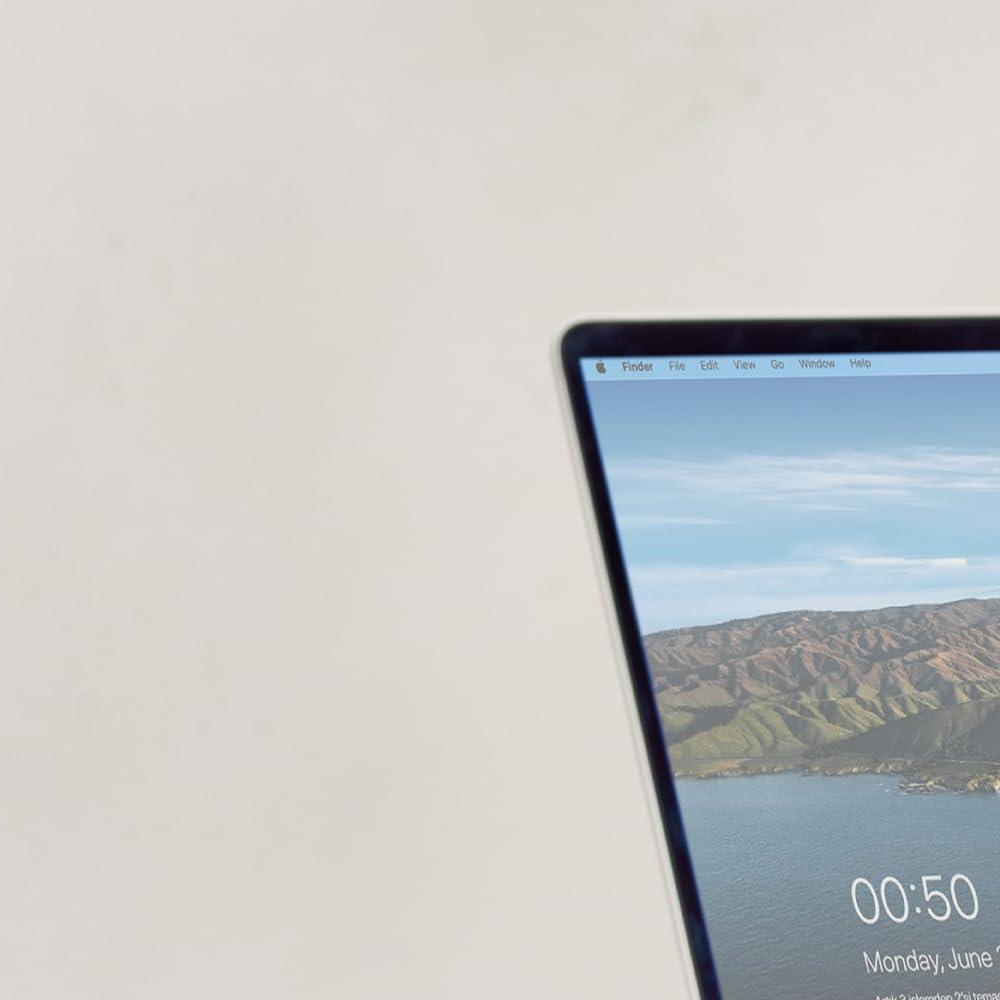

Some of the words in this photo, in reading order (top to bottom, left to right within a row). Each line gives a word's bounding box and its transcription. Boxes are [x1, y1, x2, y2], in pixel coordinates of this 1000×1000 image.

[621, 360, 653, 372] Finder
[668, 360, 686, 372] File
[700, 359, 719, 371] Edit
[732, 359, 756, 370] View
[770, 359, 785, 370] Go
[798, 358, 836, 369] Window
[849, 357, 872, 370] Help
[851, 873, 979, 925] 00:50
[862, 948, 945, 976] Monday,
[947, 946, 993, 970] June
